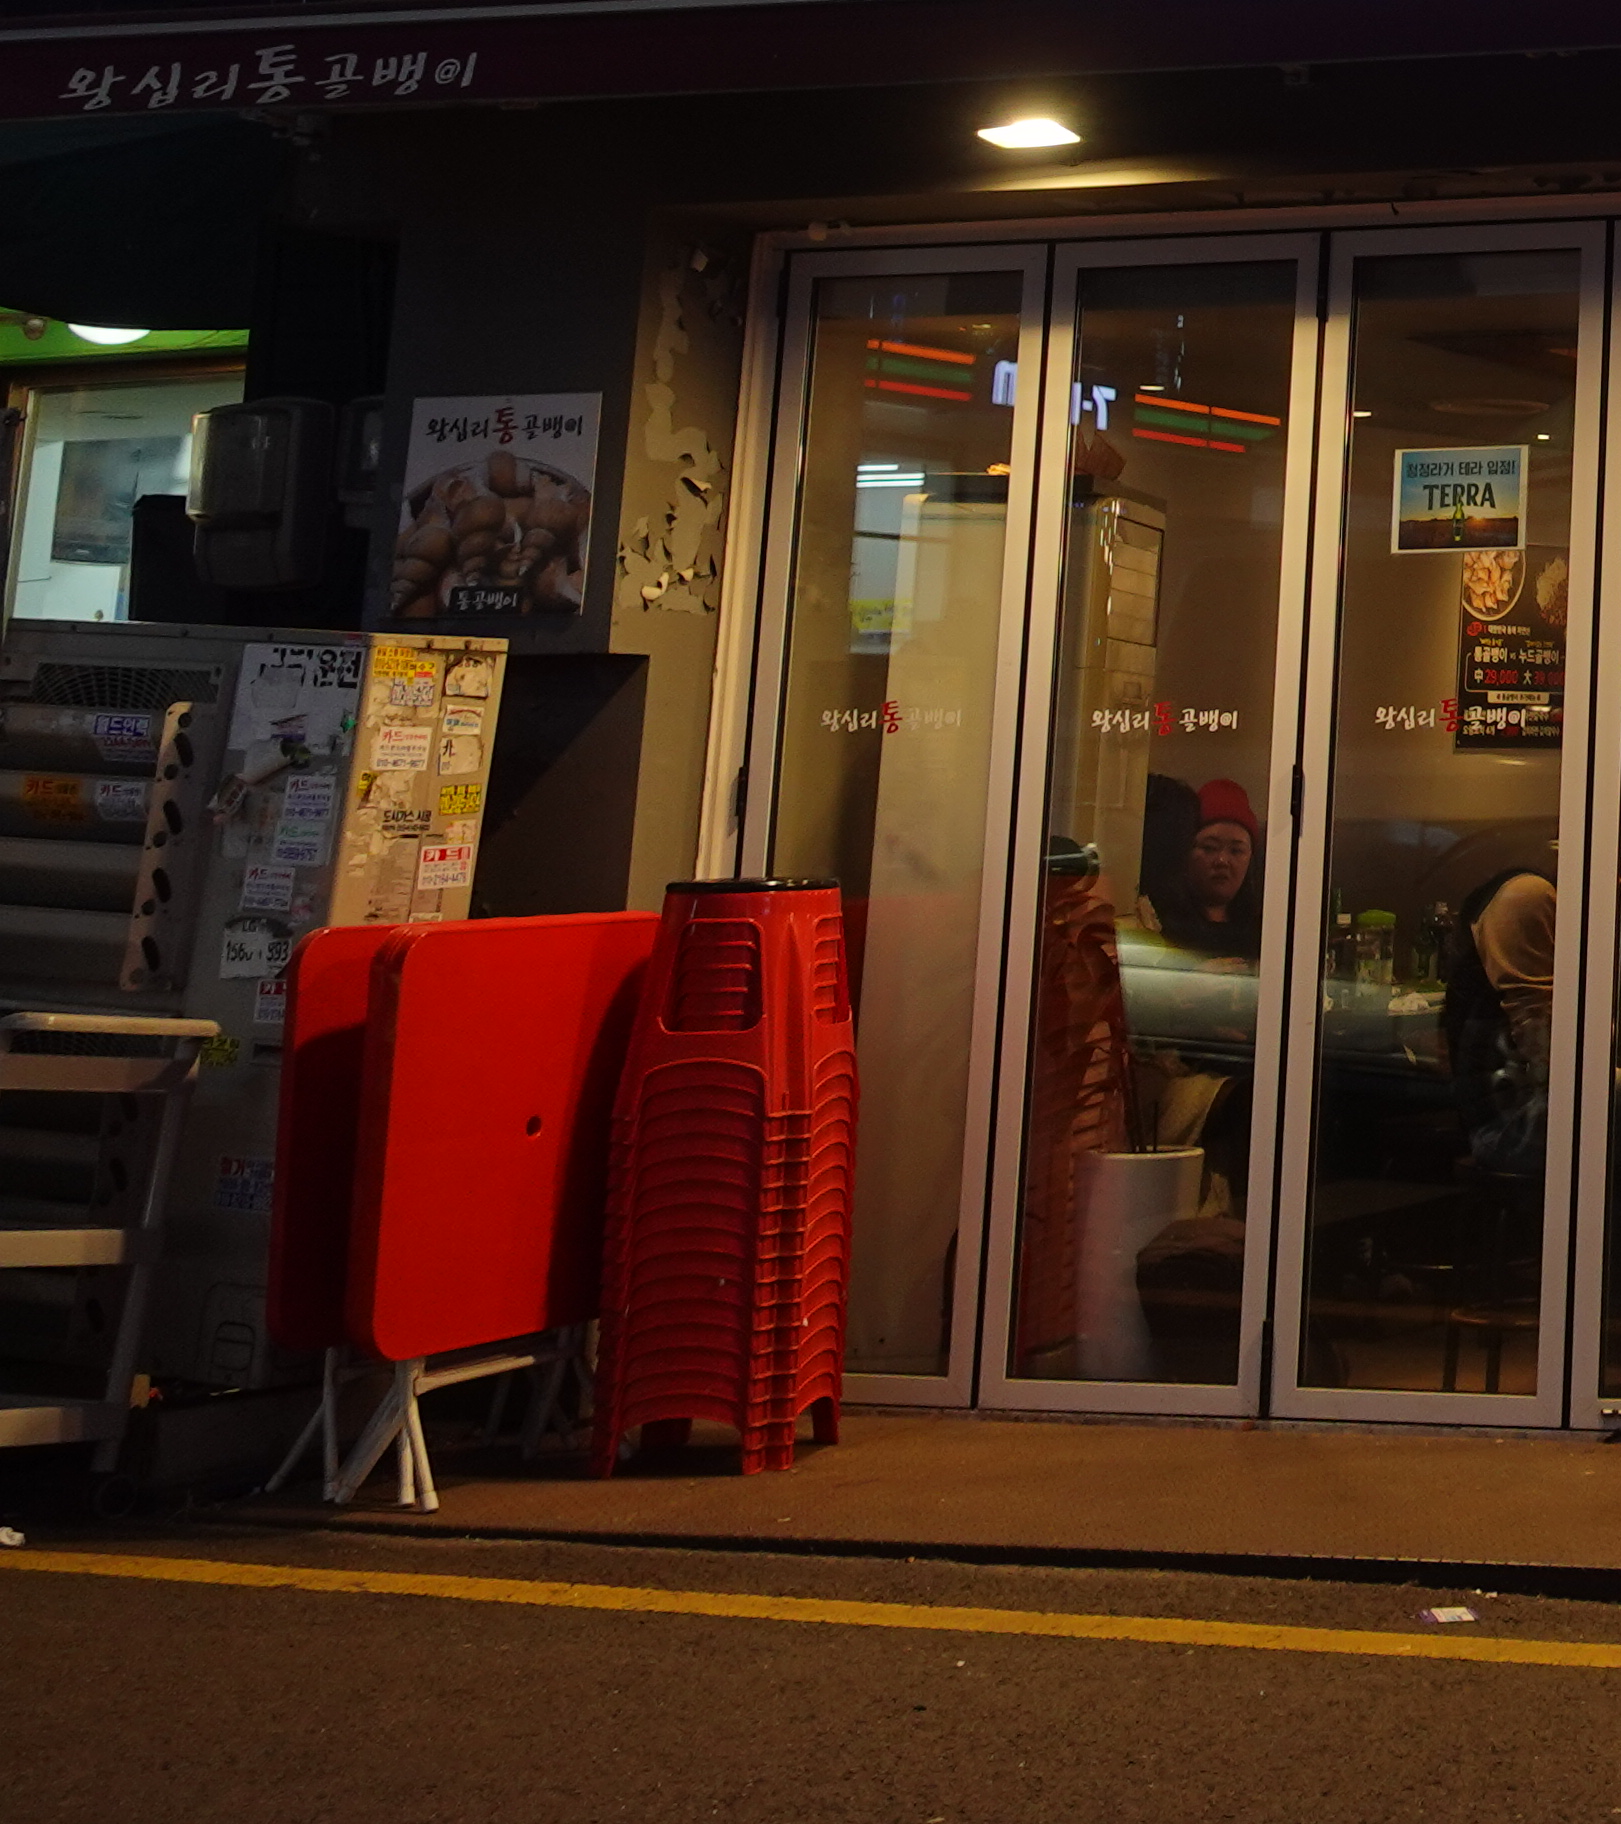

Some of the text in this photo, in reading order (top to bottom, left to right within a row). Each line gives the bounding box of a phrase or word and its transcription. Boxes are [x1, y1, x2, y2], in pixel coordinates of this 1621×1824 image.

[1407, 459, 1517, 478] 청정라거 테라 입점!
[1423, 482, 1496, 510] TERRA
[455, 589, 520, 613] 통골뱅이
